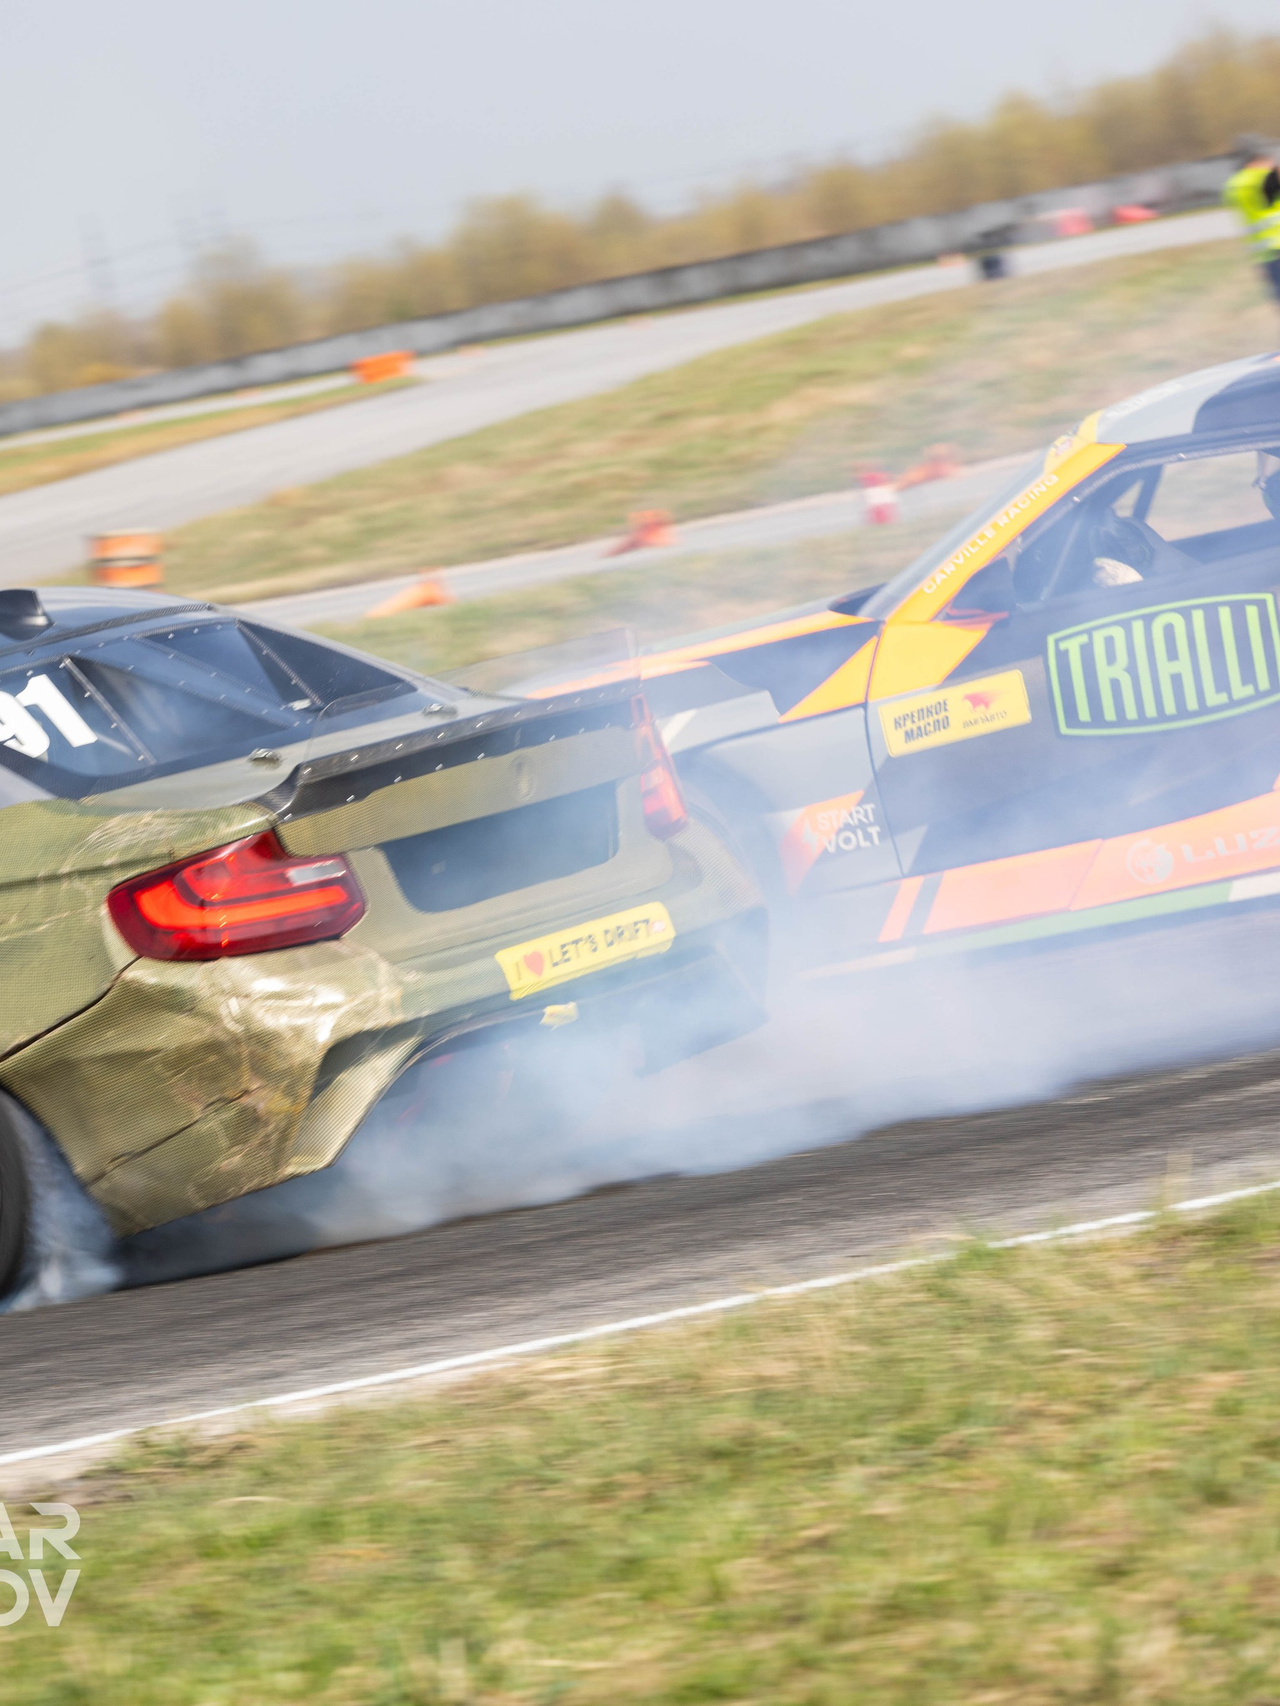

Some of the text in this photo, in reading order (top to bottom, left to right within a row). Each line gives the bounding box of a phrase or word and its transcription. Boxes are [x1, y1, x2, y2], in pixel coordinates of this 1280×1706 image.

[995, 473, 1060, 528] RACING
[1058, 604, 1271, 723] TRIALLI
[893, 699, 949, 731] КРЕПКОЕ
[903, 714, 951, 744] МАСЛО
[816, 803, 876, 831] START
[821, 825, 881, 854] VOLT
[1181, 826, 1280, 863] LUZ
[547, 933, 600, 969] LET'S
[603, 918, 651, 948] DRIFT
